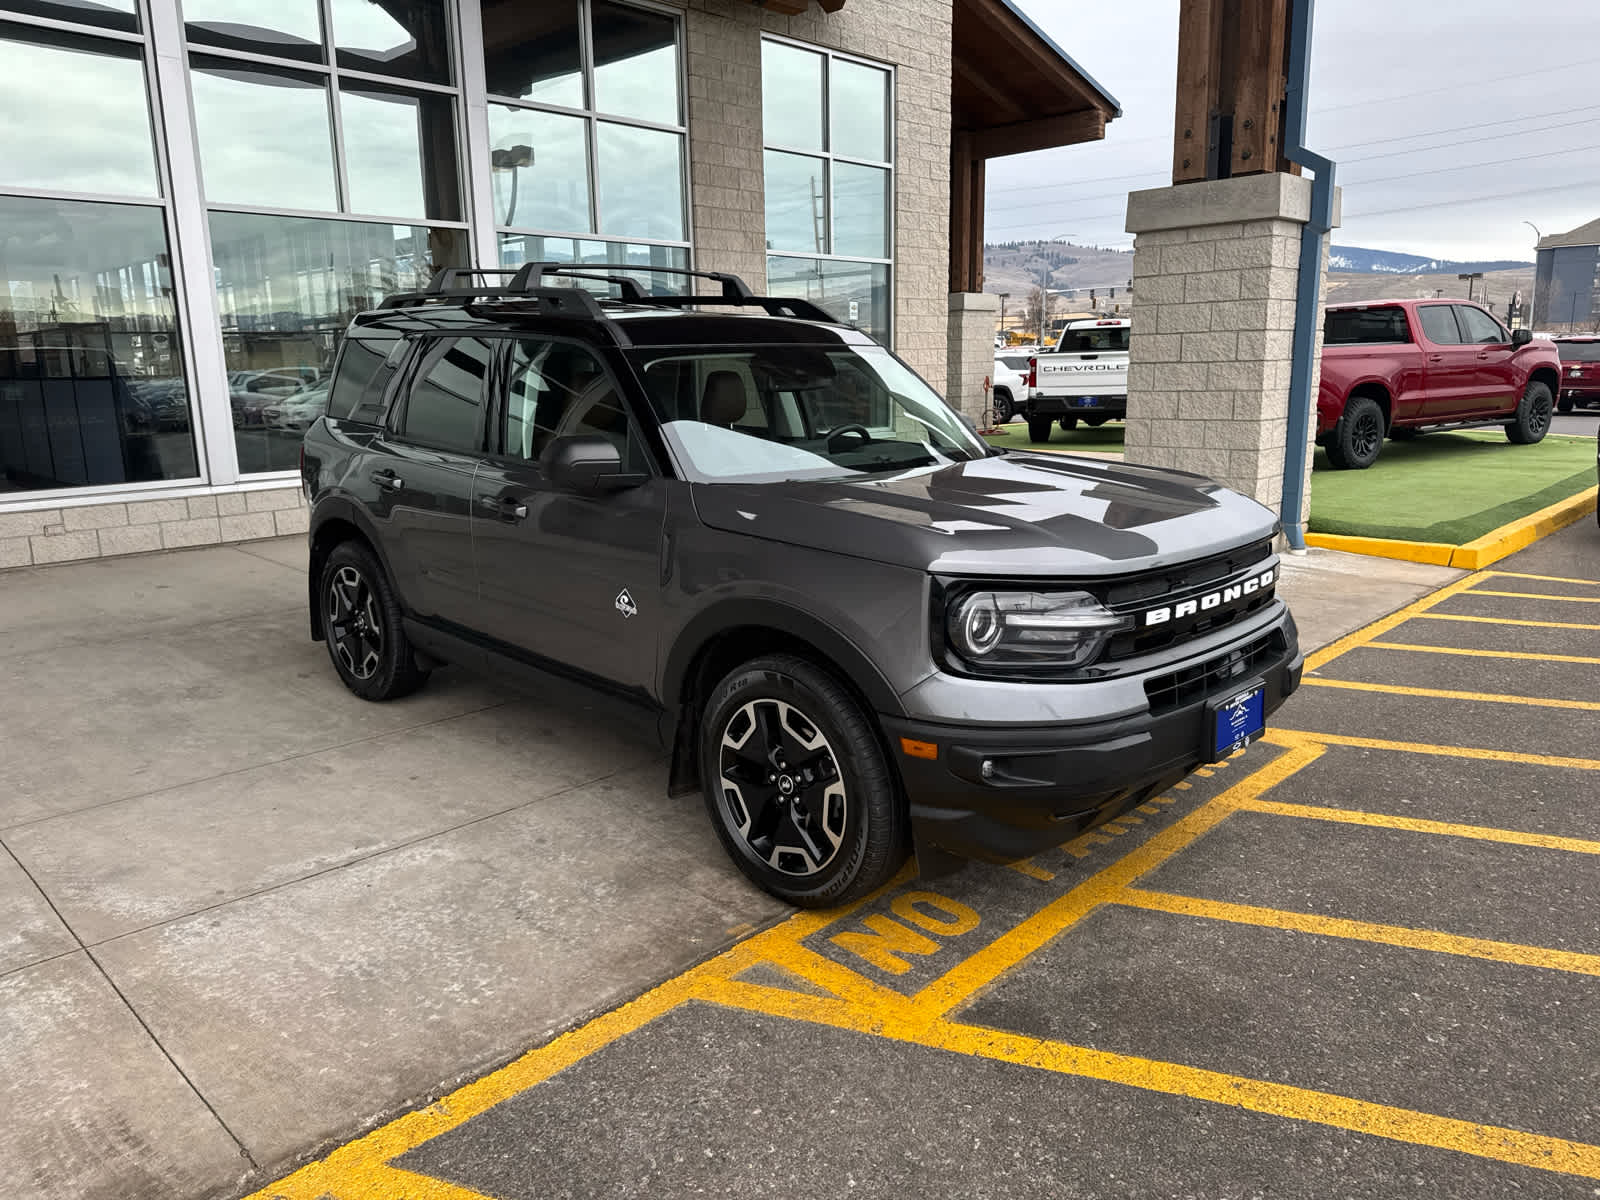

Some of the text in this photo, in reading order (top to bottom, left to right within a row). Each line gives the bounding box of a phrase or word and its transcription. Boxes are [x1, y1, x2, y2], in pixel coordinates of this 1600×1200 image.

[1043, 364, 1127, 372] CHEVROLE
[1145, 570, 1274, 626] BRONCO
[829, 891, 982, 975] NO
